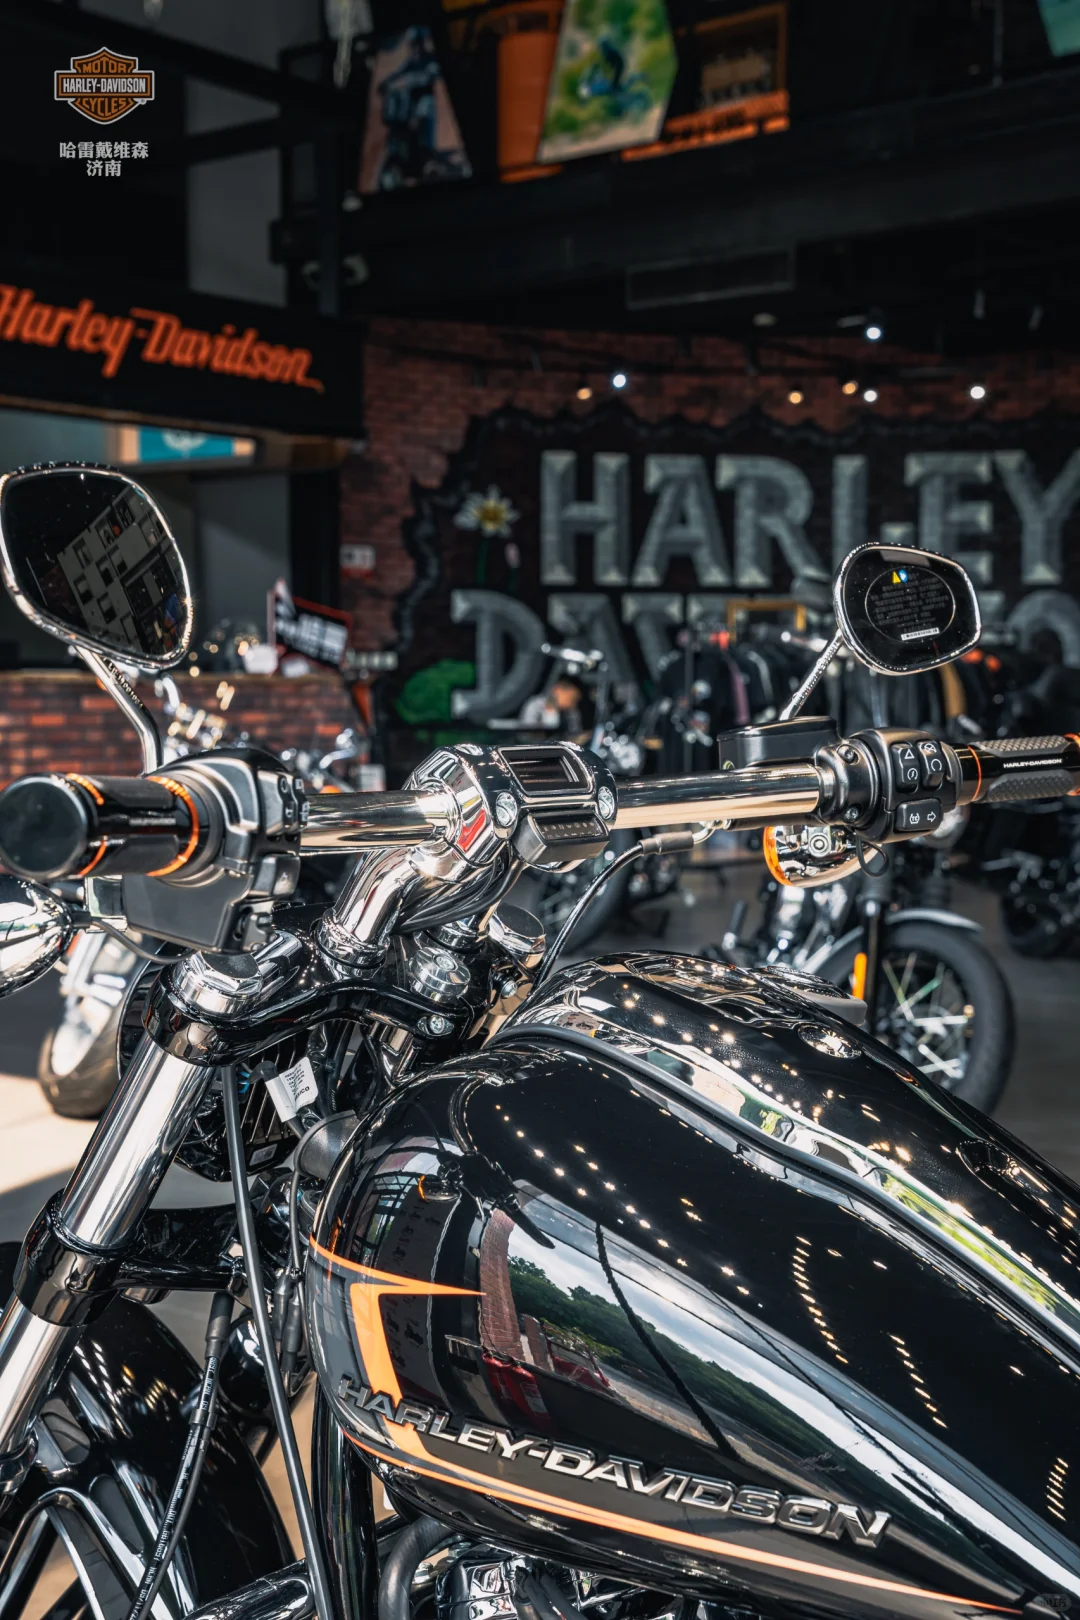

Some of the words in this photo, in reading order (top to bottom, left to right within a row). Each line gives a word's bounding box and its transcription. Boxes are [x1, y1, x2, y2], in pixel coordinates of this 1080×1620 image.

[0, 284, 325, 394] Harley-Davidson
[1003, 758, 1063, 769] HARLEY-DAVIDSON
[338, 1377, 891, 1549] HARLEY-DAVIDSON
